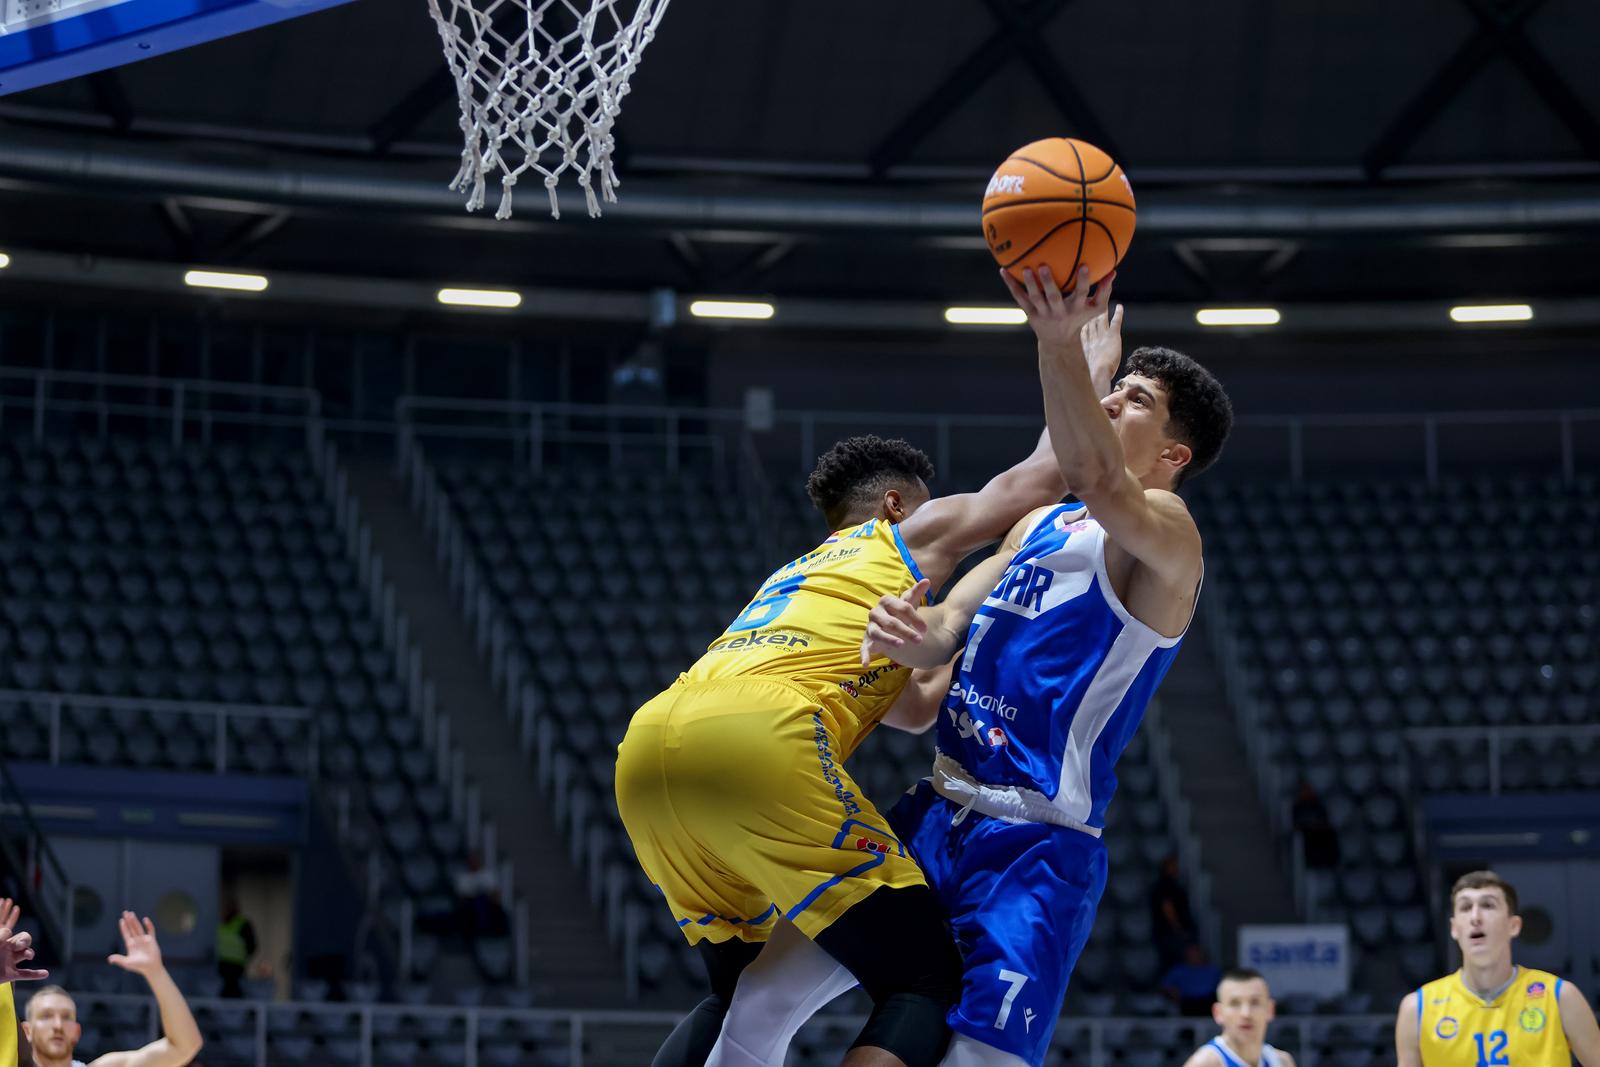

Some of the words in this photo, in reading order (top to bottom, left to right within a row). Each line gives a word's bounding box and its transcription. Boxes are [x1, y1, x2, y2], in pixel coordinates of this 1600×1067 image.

[961, 614, 995, 673] 7
[993, 968, 1029, 1031] 7
[1473, 1029, 1509, 1067] 12
